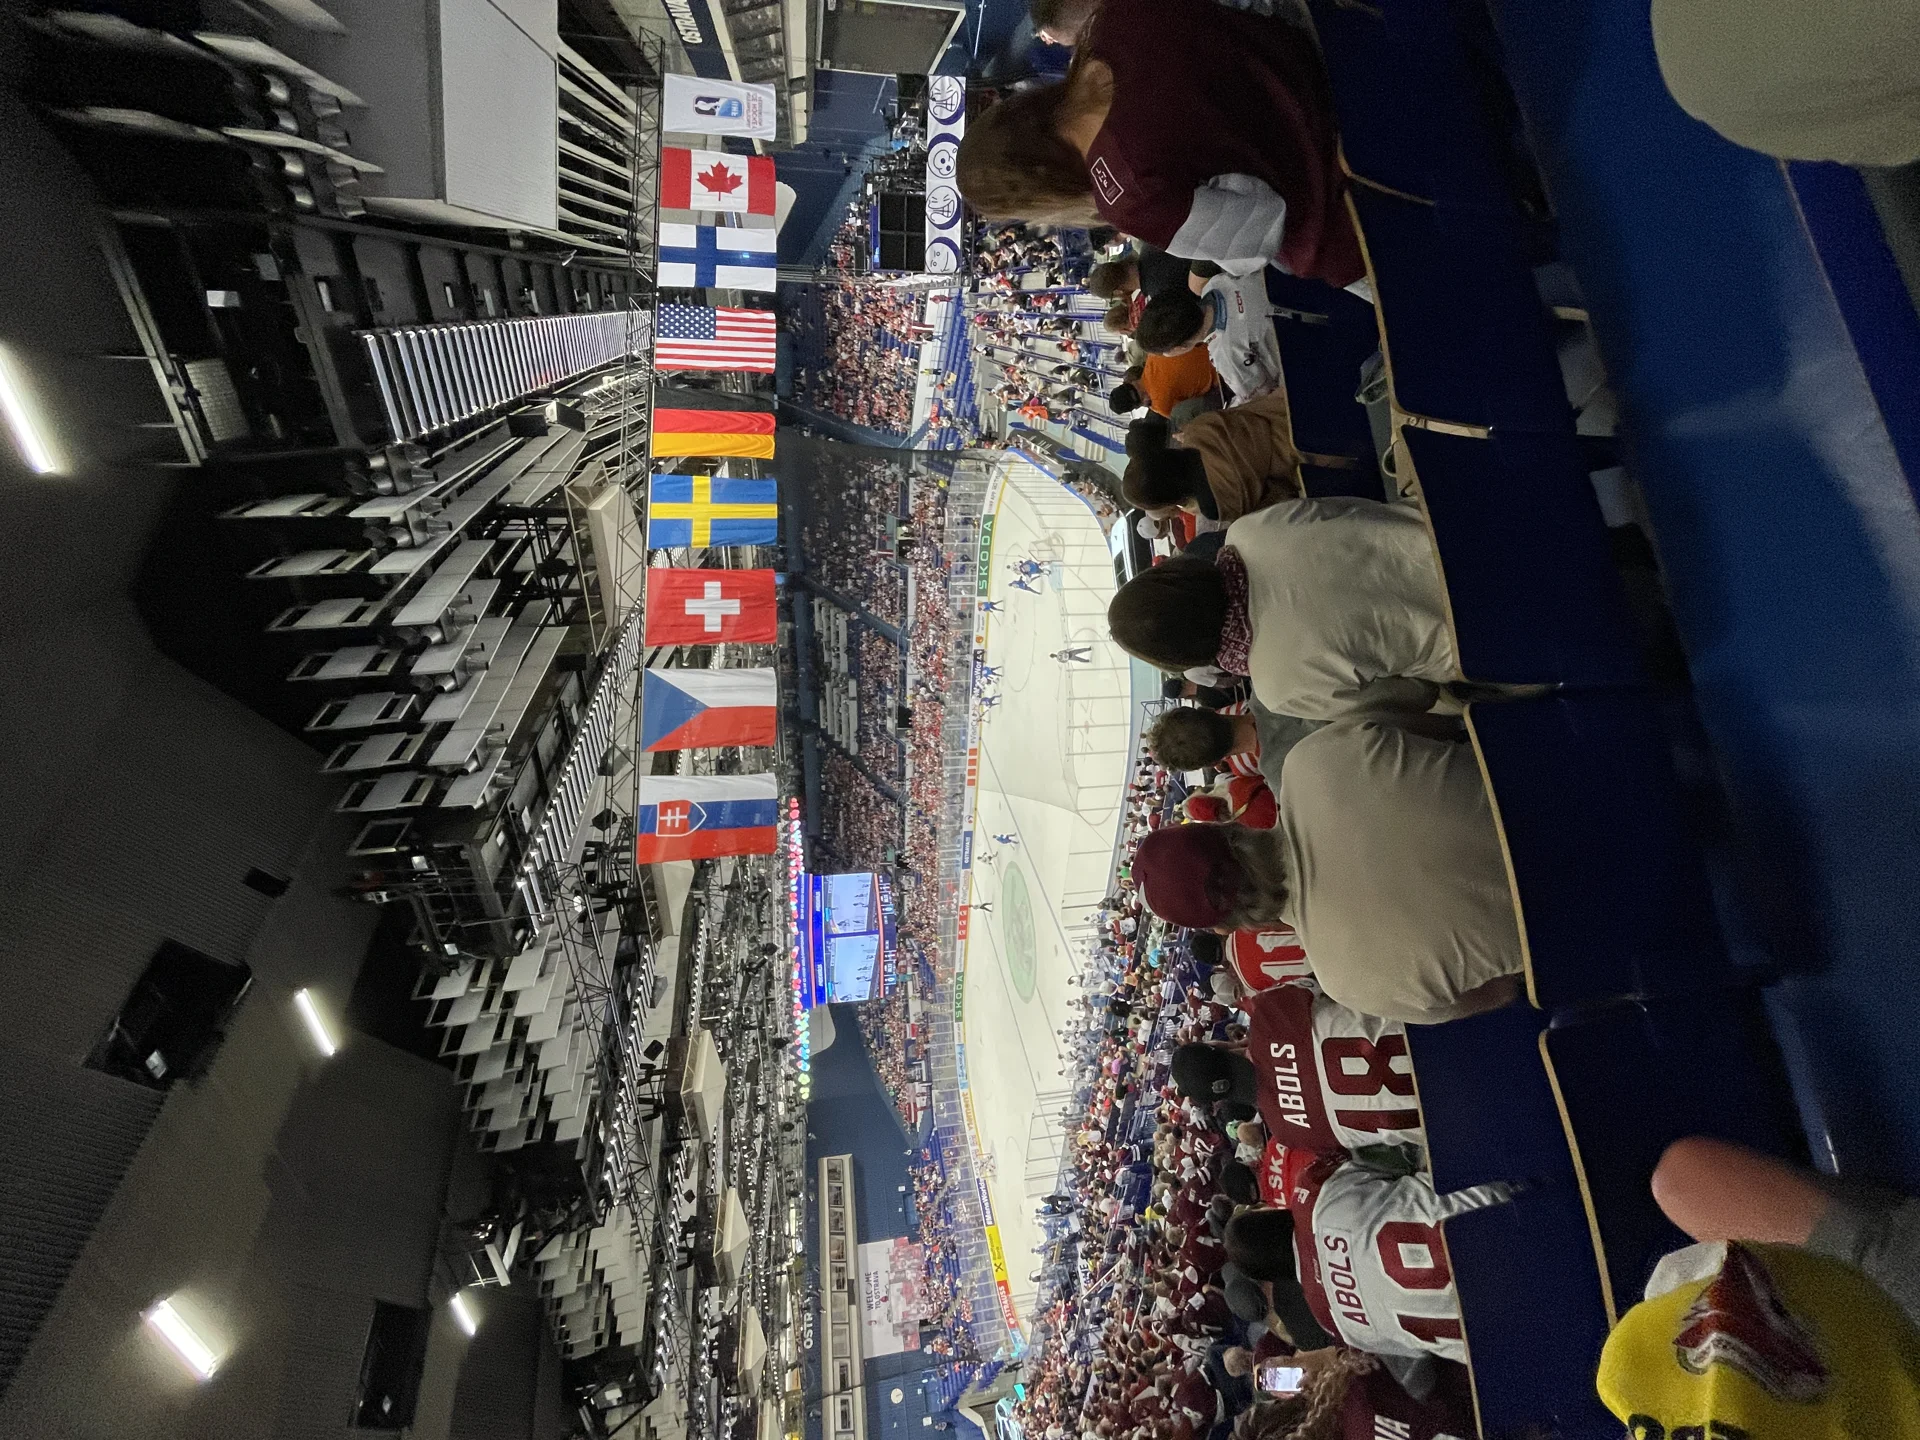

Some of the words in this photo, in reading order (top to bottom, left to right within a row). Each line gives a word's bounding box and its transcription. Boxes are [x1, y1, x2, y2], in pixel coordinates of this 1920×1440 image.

[1234, 290, 1244, 314] CCM
[1256, 930, 1314, 980] 11
[1270, 1042, 1310, 1128] ABOLS
[1321, 1034, 1421, 1133] 18
[1268, 1142, 1288, 1209] LSKA
[872, 1270, 881, 1299] OSTRAVA
[874, 1300, 881, 1310] TO
[998, 1285, 1012, 1318] STRAUSS
[1324, 1235, 1370, 1326] ABOLS
